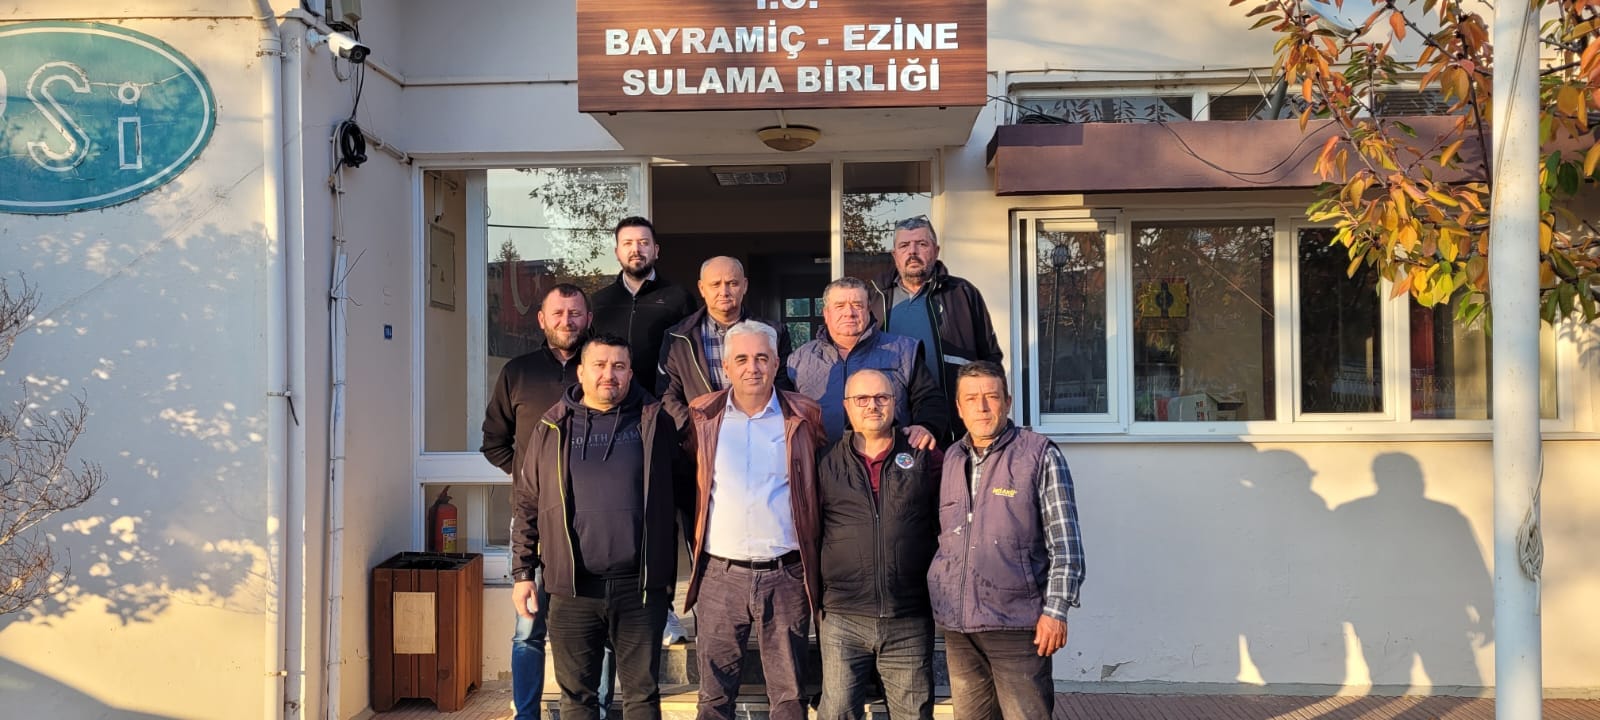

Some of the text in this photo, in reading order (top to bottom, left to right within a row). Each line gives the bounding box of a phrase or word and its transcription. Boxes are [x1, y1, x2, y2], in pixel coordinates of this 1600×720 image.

[606, 17, 958, 59] BAYRAMİÇ - EZİNE
[623, 58, 940, 95] SULAMA BİRLİĞİ
